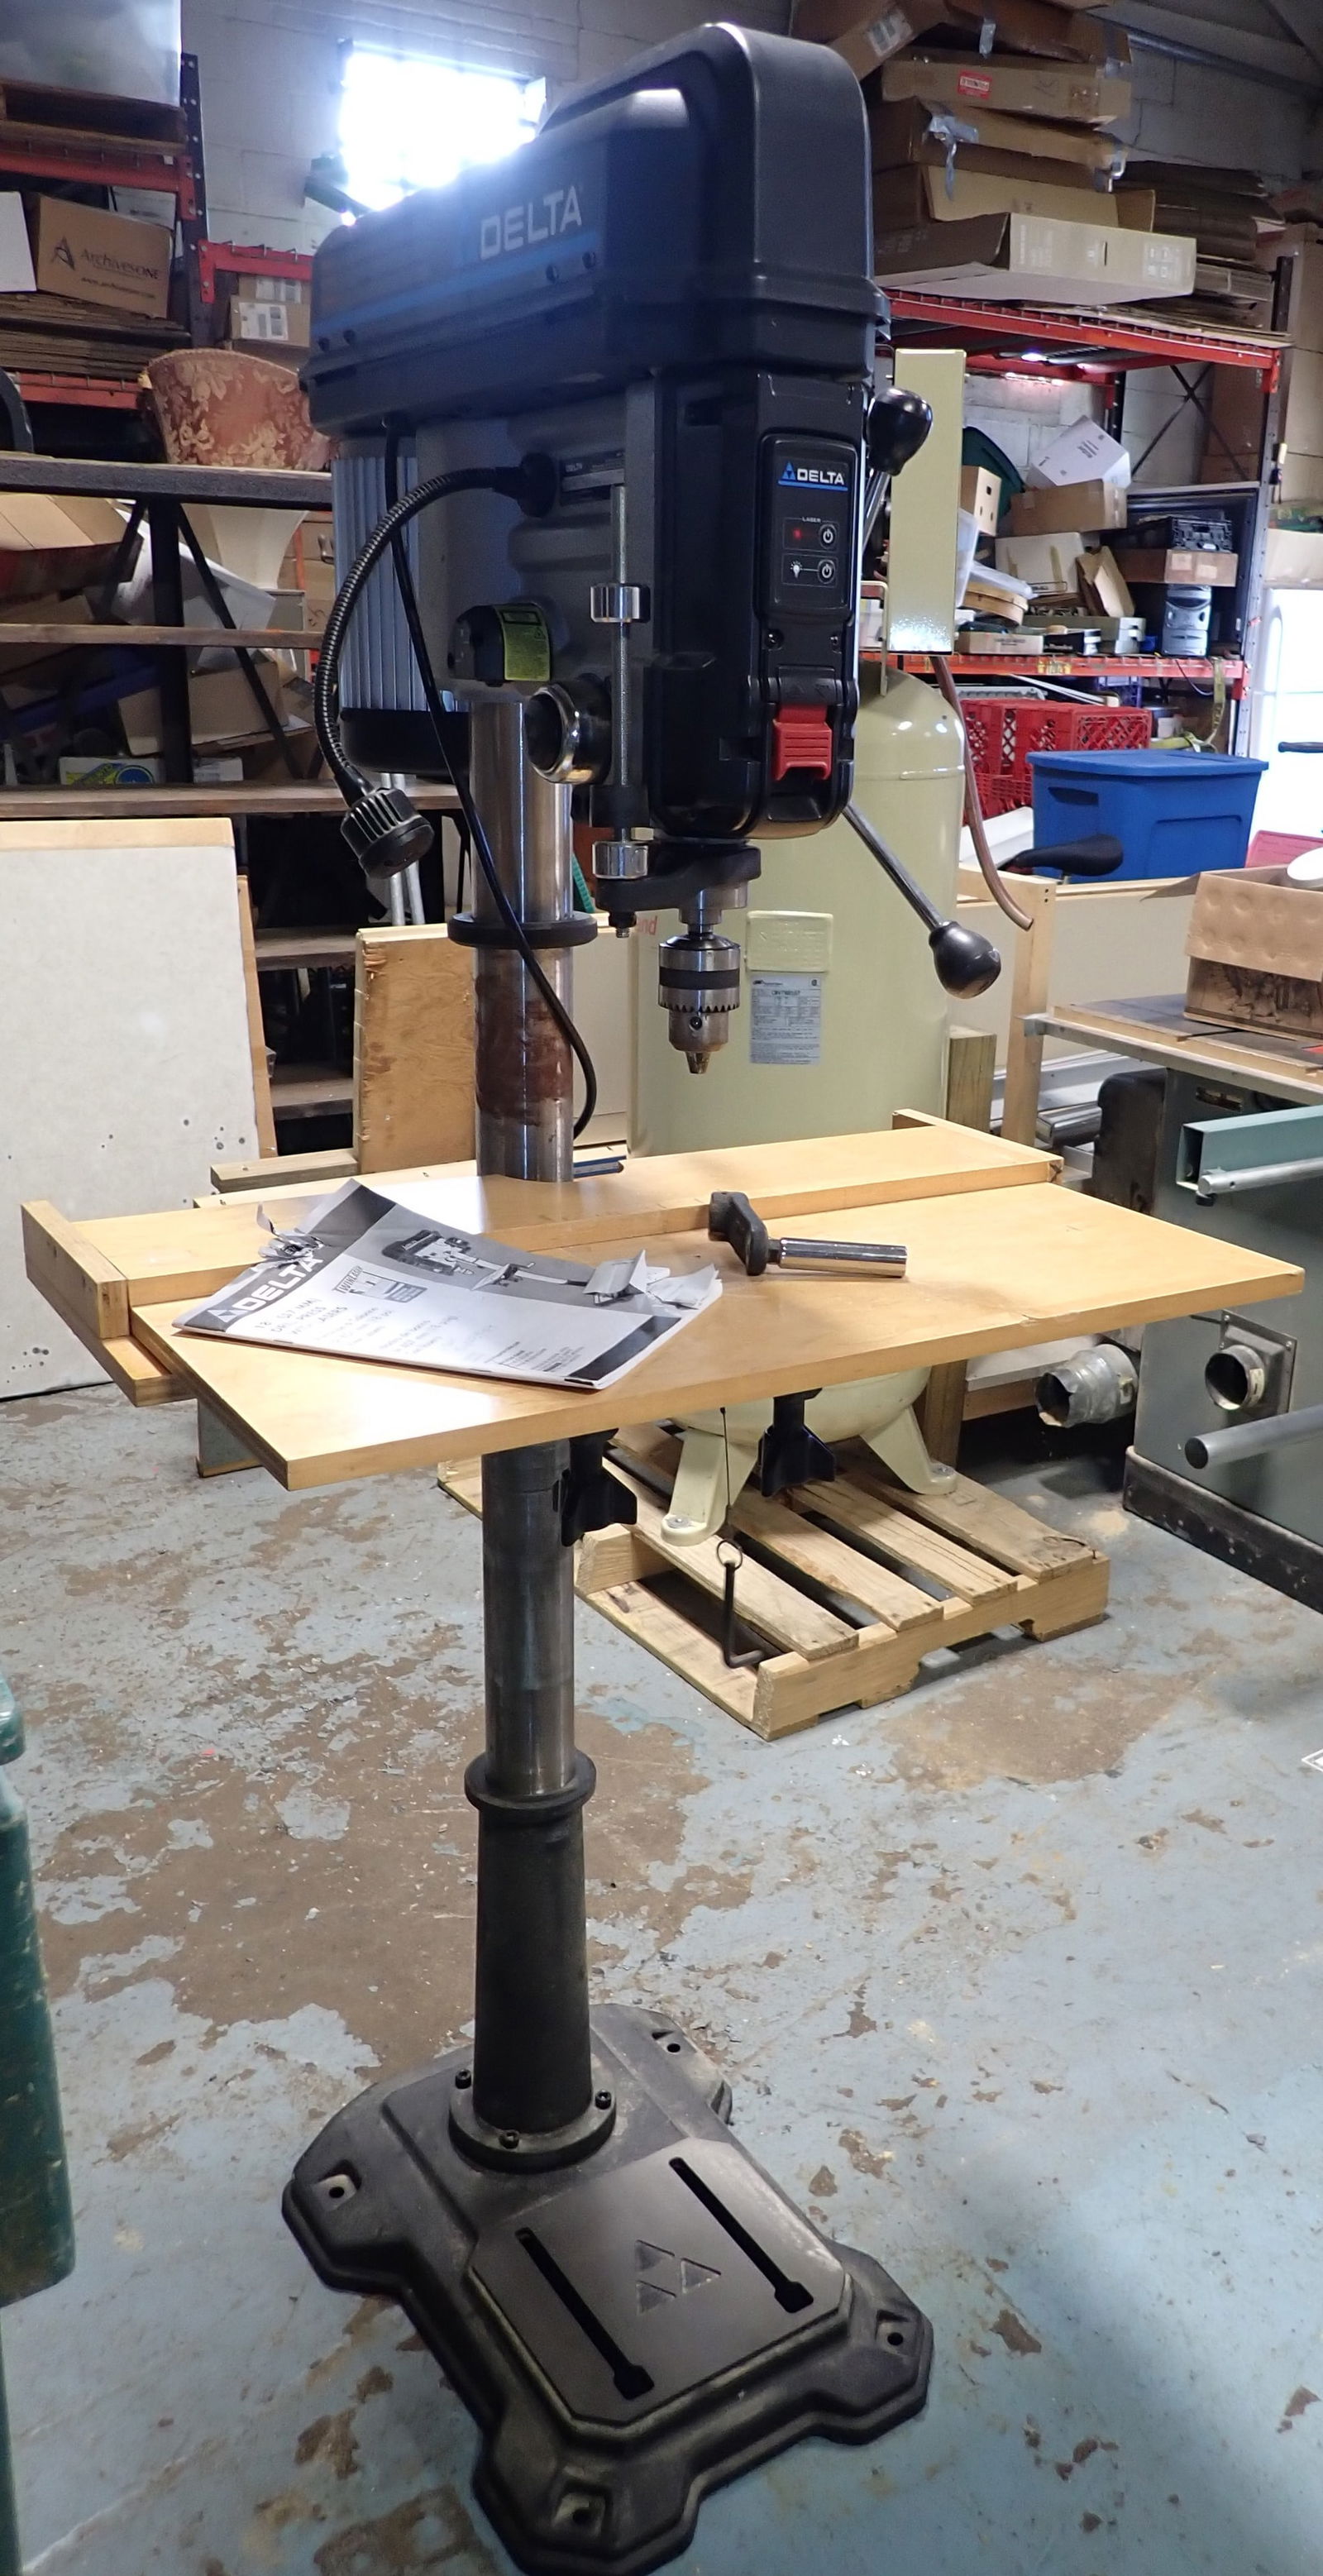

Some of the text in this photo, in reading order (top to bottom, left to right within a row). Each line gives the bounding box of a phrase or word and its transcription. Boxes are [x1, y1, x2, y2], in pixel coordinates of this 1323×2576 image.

[480, 184, 582, 260] DELTA
[796, 467, 845, 485] DELTA
[231, 1248, 324, 1312] DELTA
